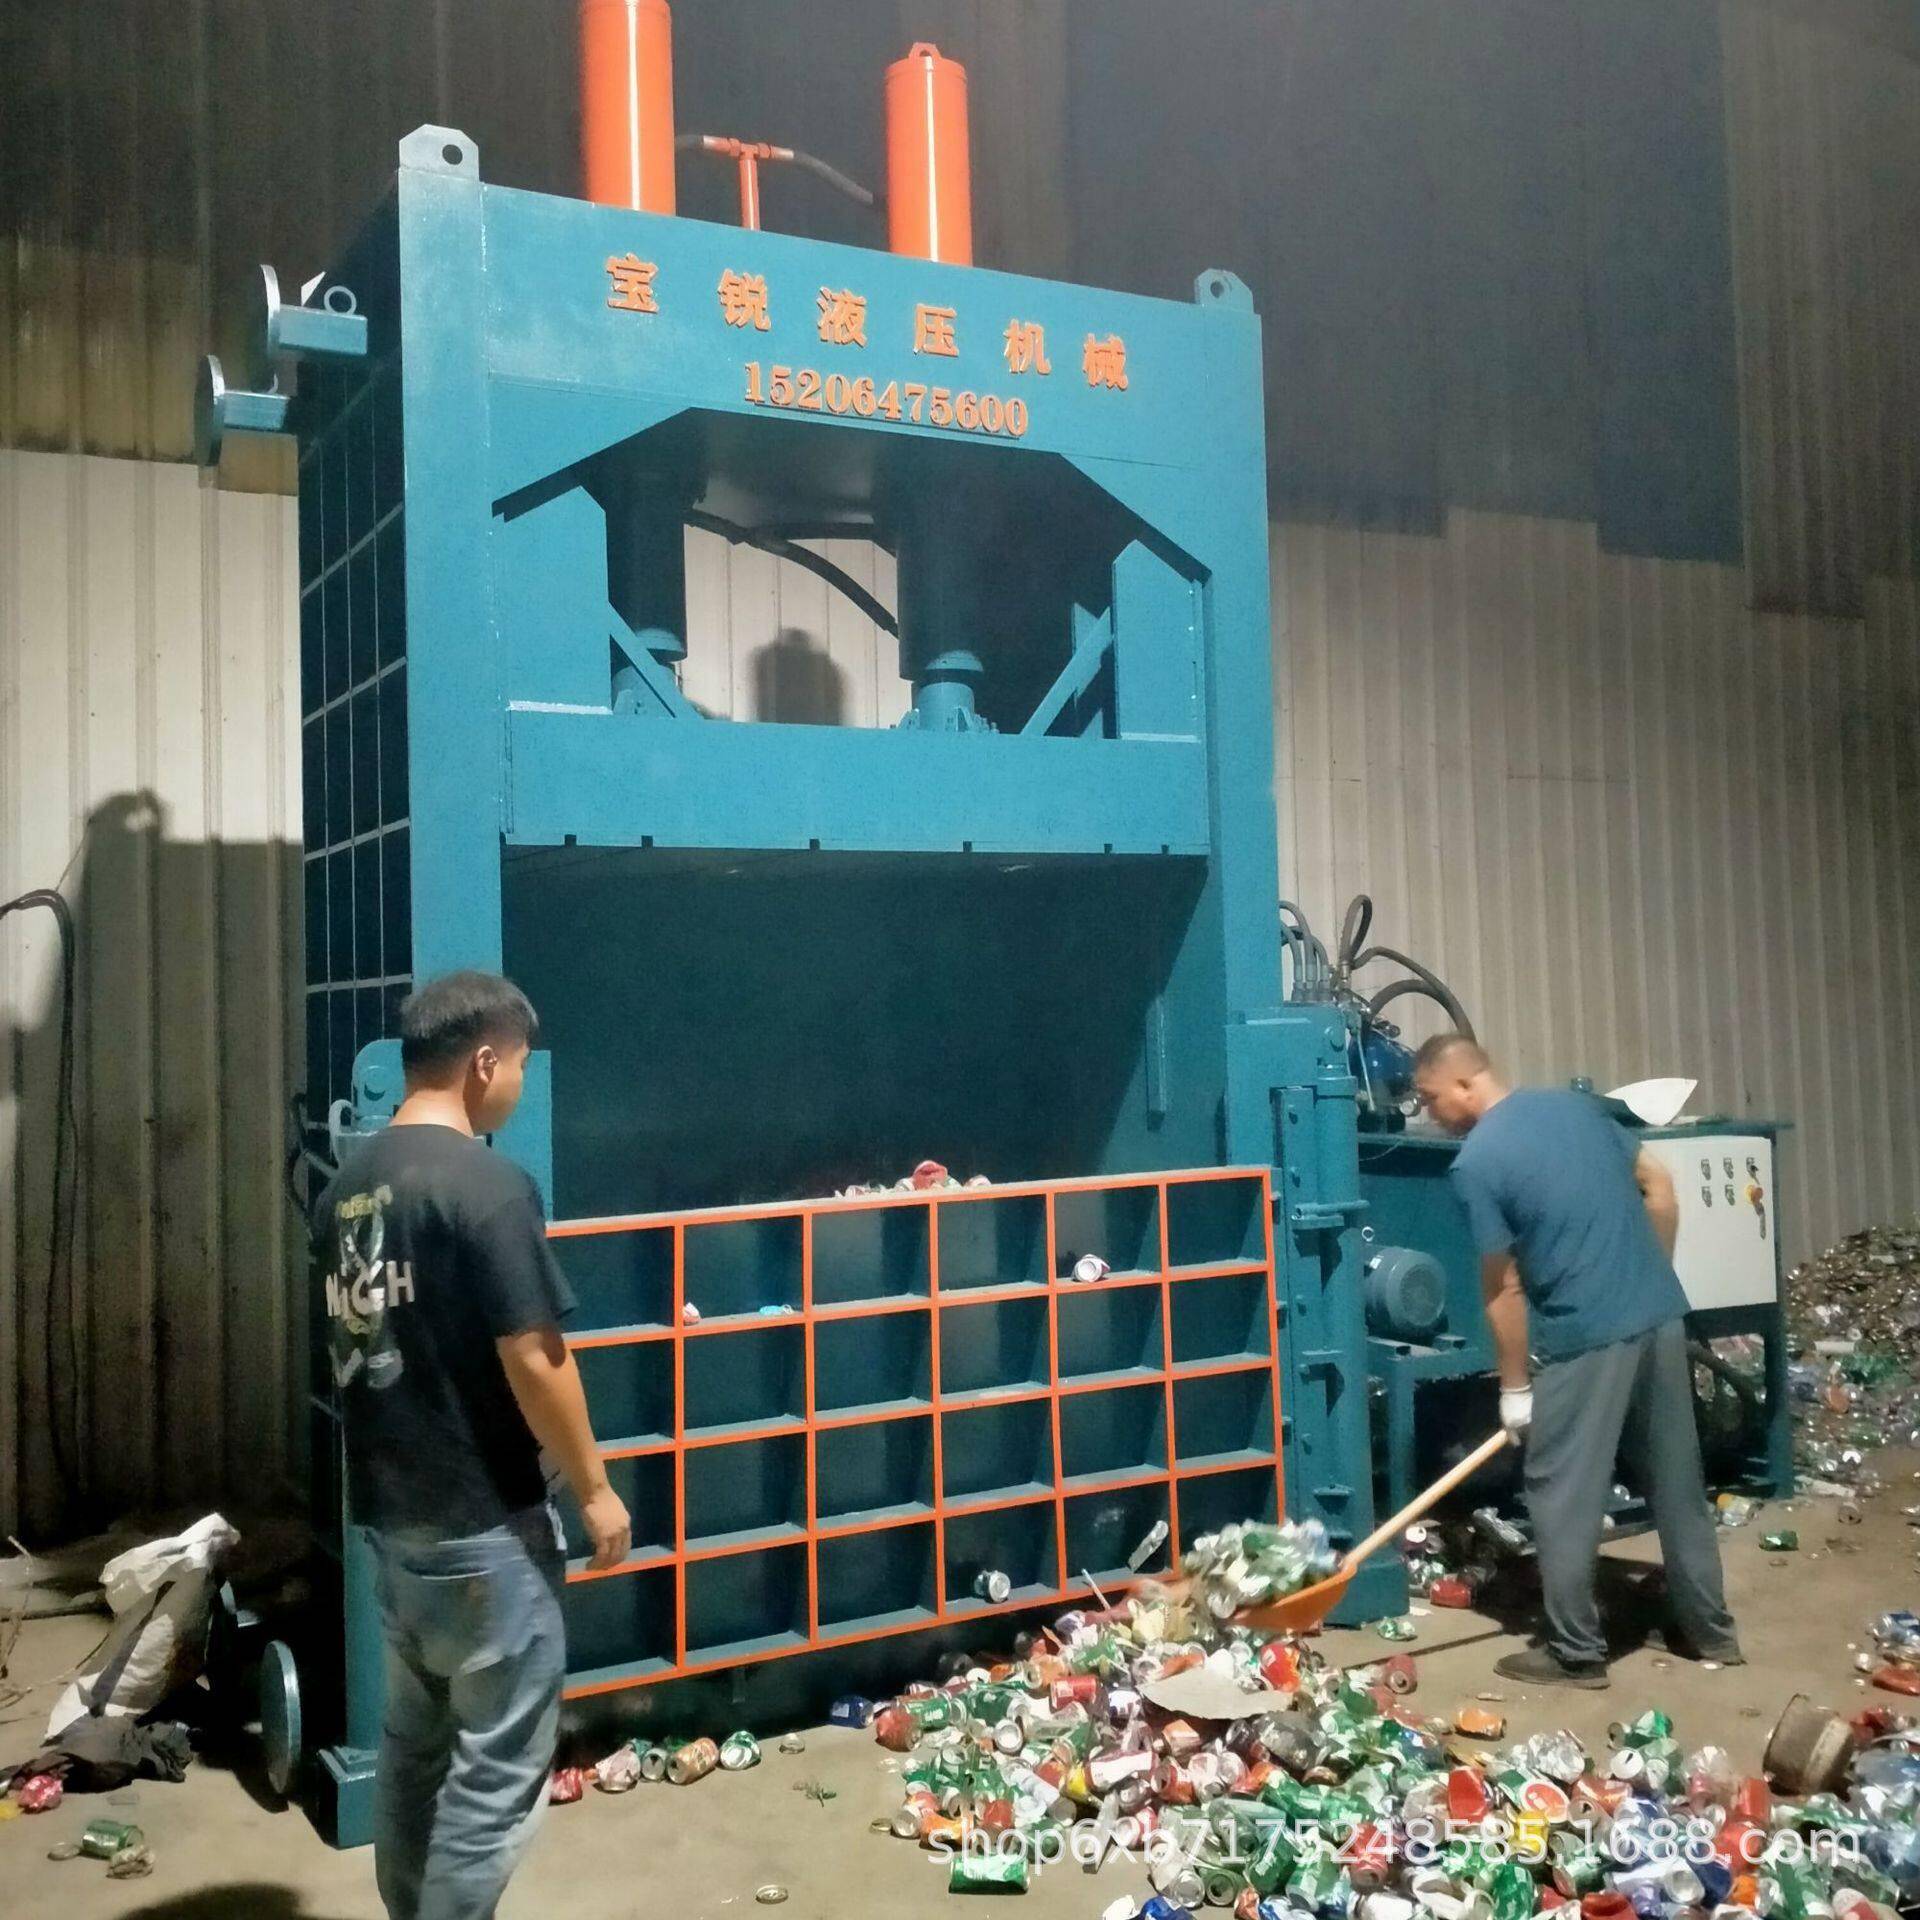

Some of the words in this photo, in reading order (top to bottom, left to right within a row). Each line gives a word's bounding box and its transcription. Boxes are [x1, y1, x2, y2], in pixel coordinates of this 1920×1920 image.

[606, 253, 1128, 390] 宝锐液压机械
[744, 361, 1029, 437] 15206475600
